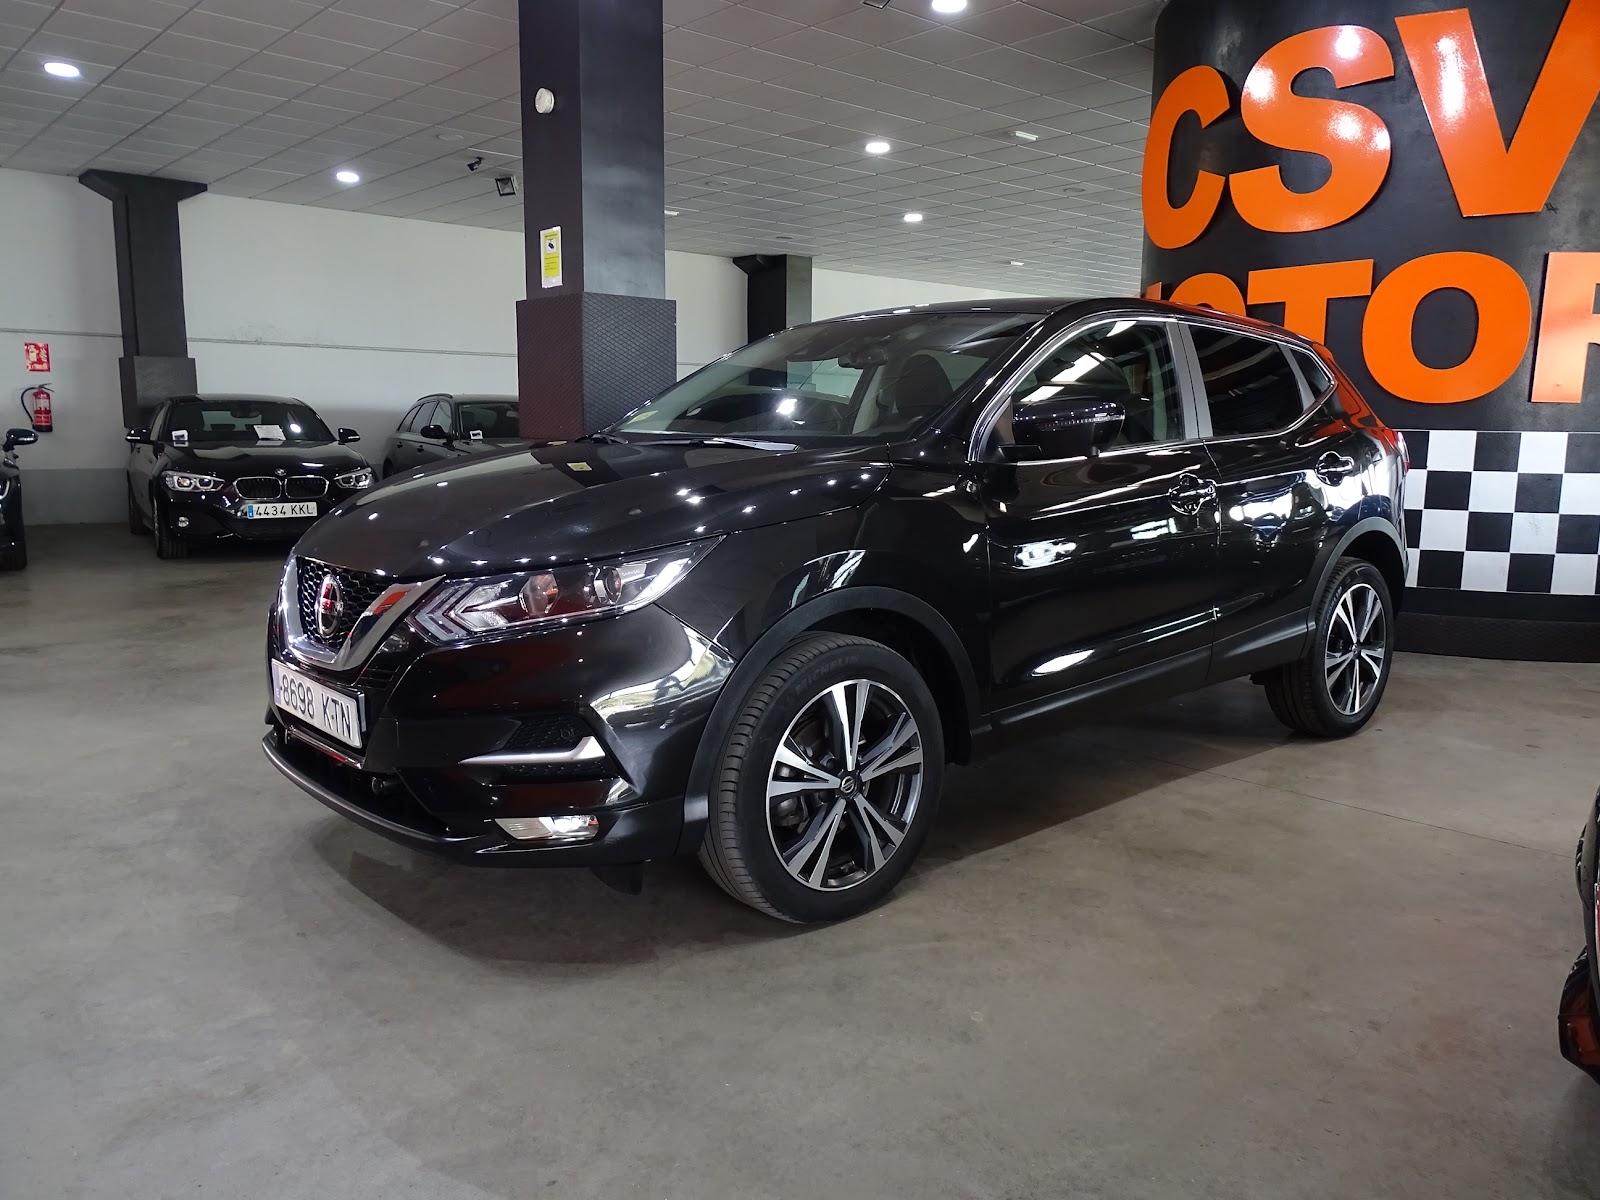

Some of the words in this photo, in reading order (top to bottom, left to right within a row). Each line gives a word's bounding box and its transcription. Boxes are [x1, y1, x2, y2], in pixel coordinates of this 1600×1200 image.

[1141, 0, 1600, 249] CSV
[255, 505, 286, 516] 4434
[291, 504, 313, 515] KKL
[282, 674, 315, 720] 8698
[321, 692, 353, 741] KTN
